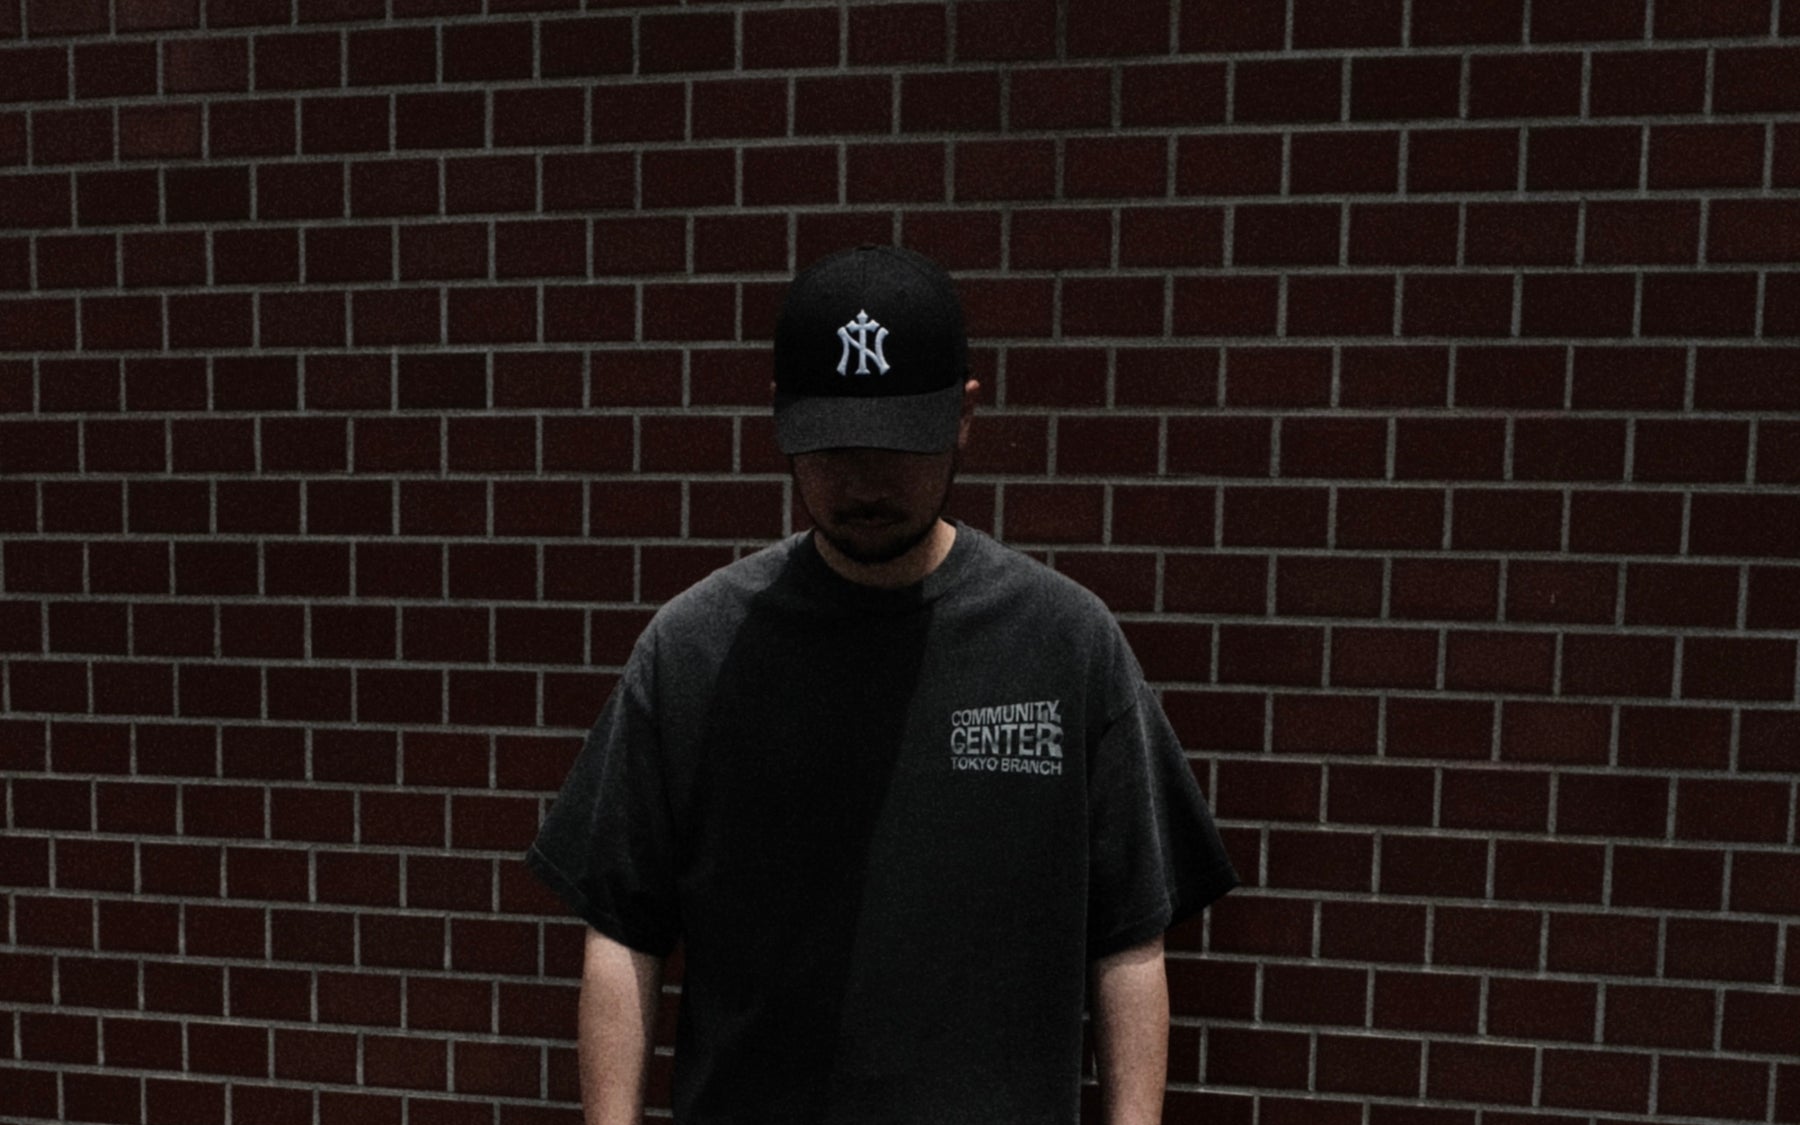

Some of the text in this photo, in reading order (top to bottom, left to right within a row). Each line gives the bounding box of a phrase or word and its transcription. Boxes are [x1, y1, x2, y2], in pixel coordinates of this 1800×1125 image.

[951, 699, 1061, 727] COMMUNITY
[950, 722, 1064, 758] CENTER
[950, 757, 1063, 776] TOKYO BRANCH
